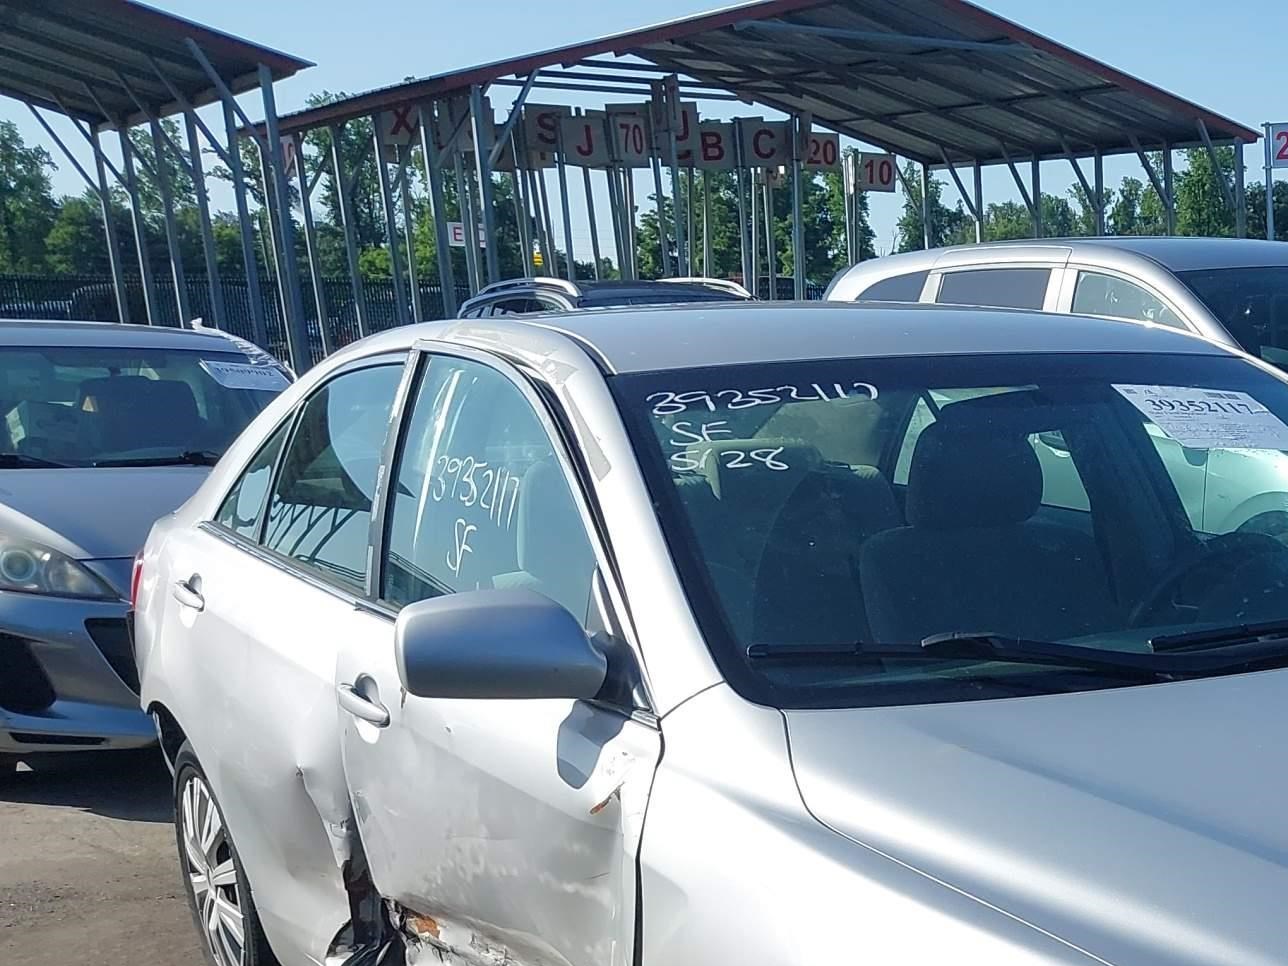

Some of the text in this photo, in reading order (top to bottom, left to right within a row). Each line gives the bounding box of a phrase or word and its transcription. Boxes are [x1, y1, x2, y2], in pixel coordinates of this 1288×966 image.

[536, 112, 561, 145] S
[576, 124, 594, 157] J
[618, 123, 644, 155] 70
[752, 128, 777, 160] C
[701, 131, 725, 161] B
[806, 139, 837, 166] 20
[864, 159, 893, 186] 10
[646, 382, 879, 415] 39352117
[1144, 399, 1254, 415] 39352117
[669, 420, 733, 447] SF
[432, 455, 522, 532] 39352117
